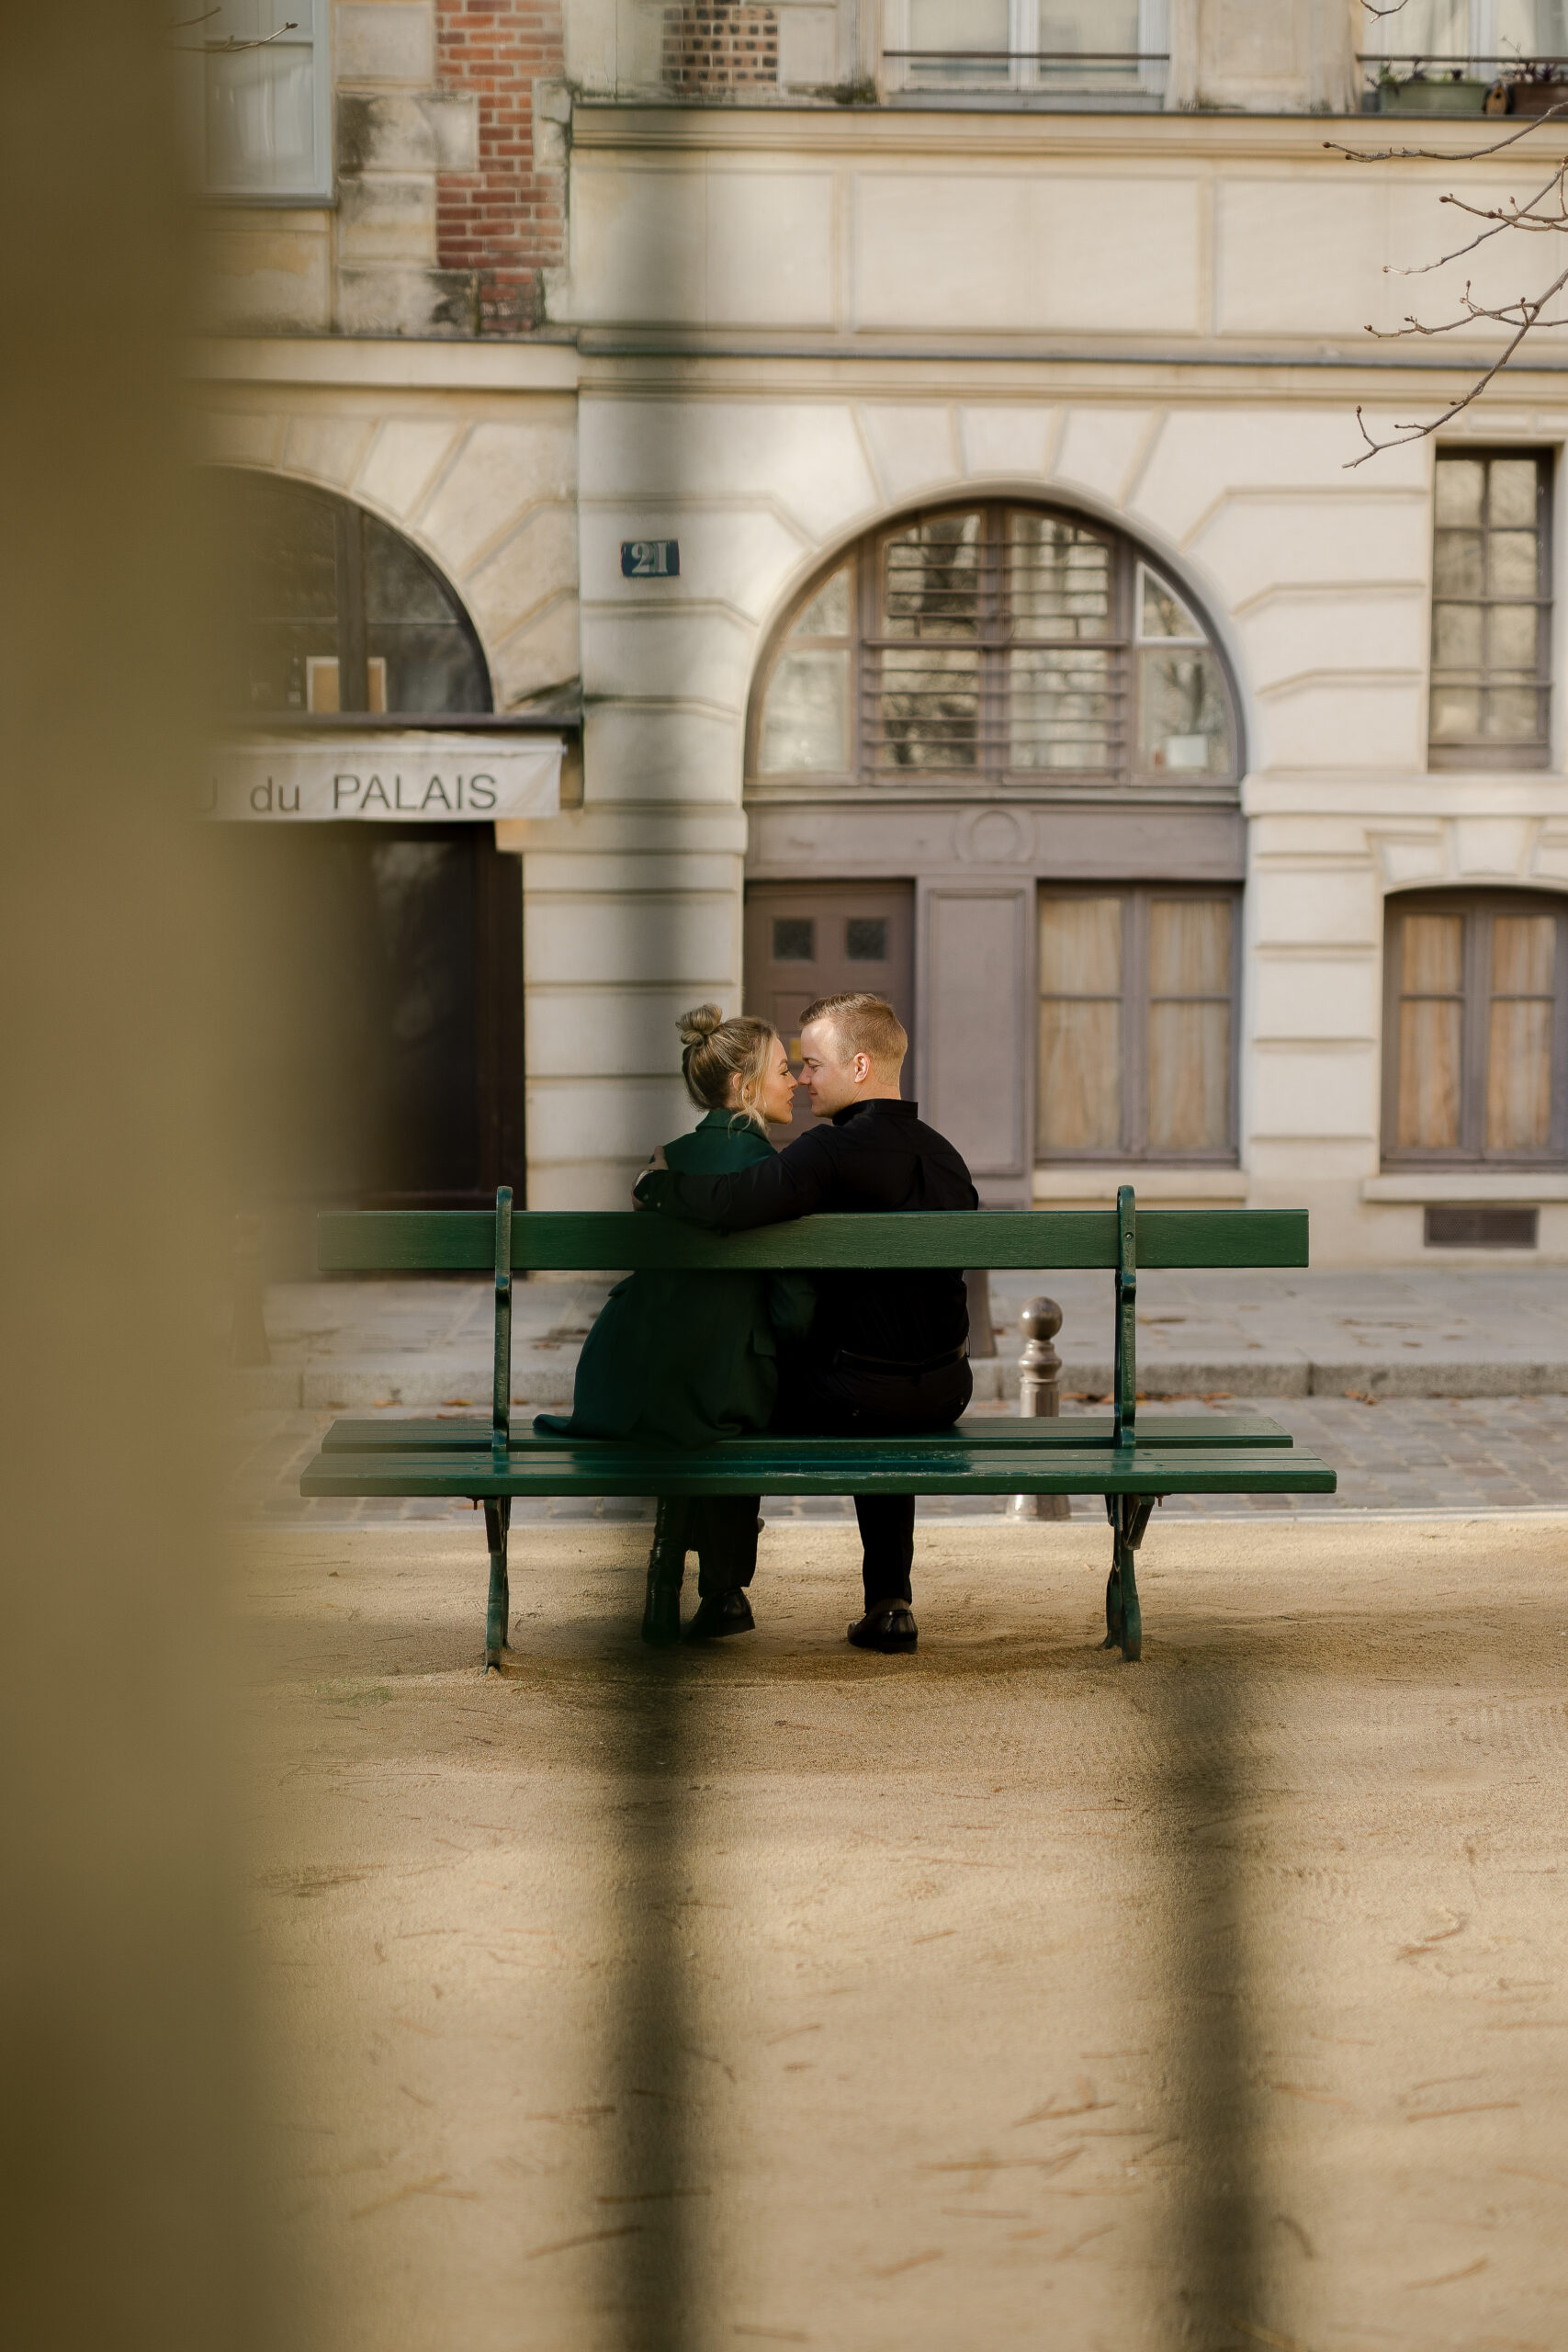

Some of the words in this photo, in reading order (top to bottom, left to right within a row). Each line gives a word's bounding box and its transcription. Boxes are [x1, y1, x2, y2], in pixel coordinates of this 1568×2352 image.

[631, 542, 668, 574] 21
[250, 775, 299, 812] du
[333, 774, 497, 810] PALAIS
